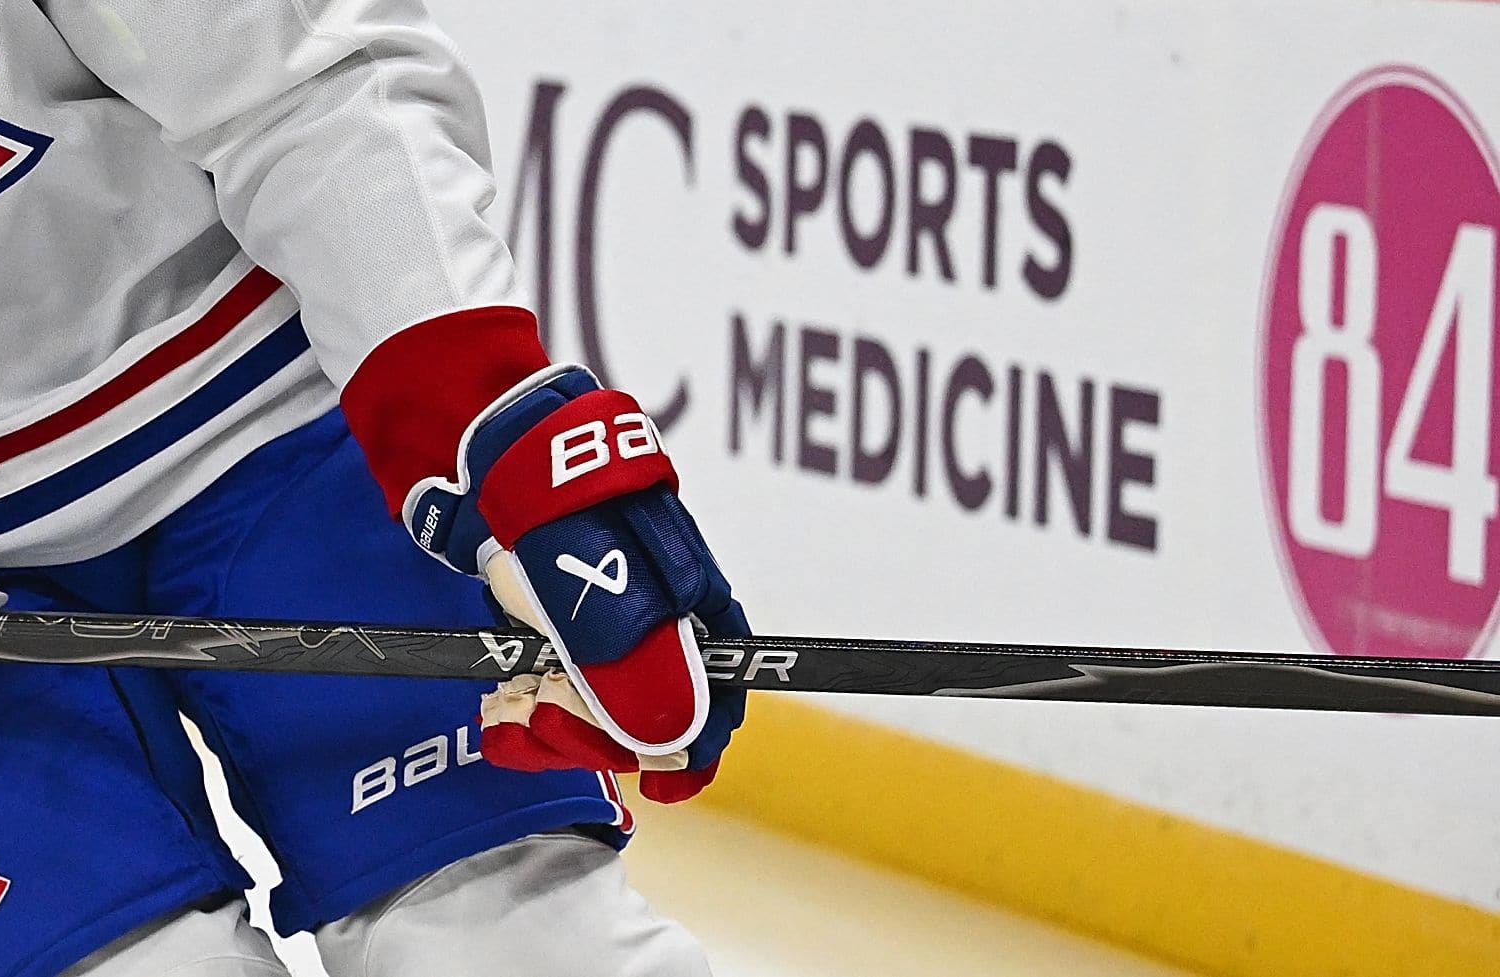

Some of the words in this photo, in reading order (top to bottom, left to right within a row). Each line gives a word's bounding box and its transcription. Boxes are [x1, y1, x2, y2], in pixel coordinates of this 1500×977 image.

[731, 105, 1075, 303] SPORTS
[729, 312, 1163, 555] MEDICINE
[1287, 202, 1499, 587] 84
[419, 504, 442, 550] BAUER
